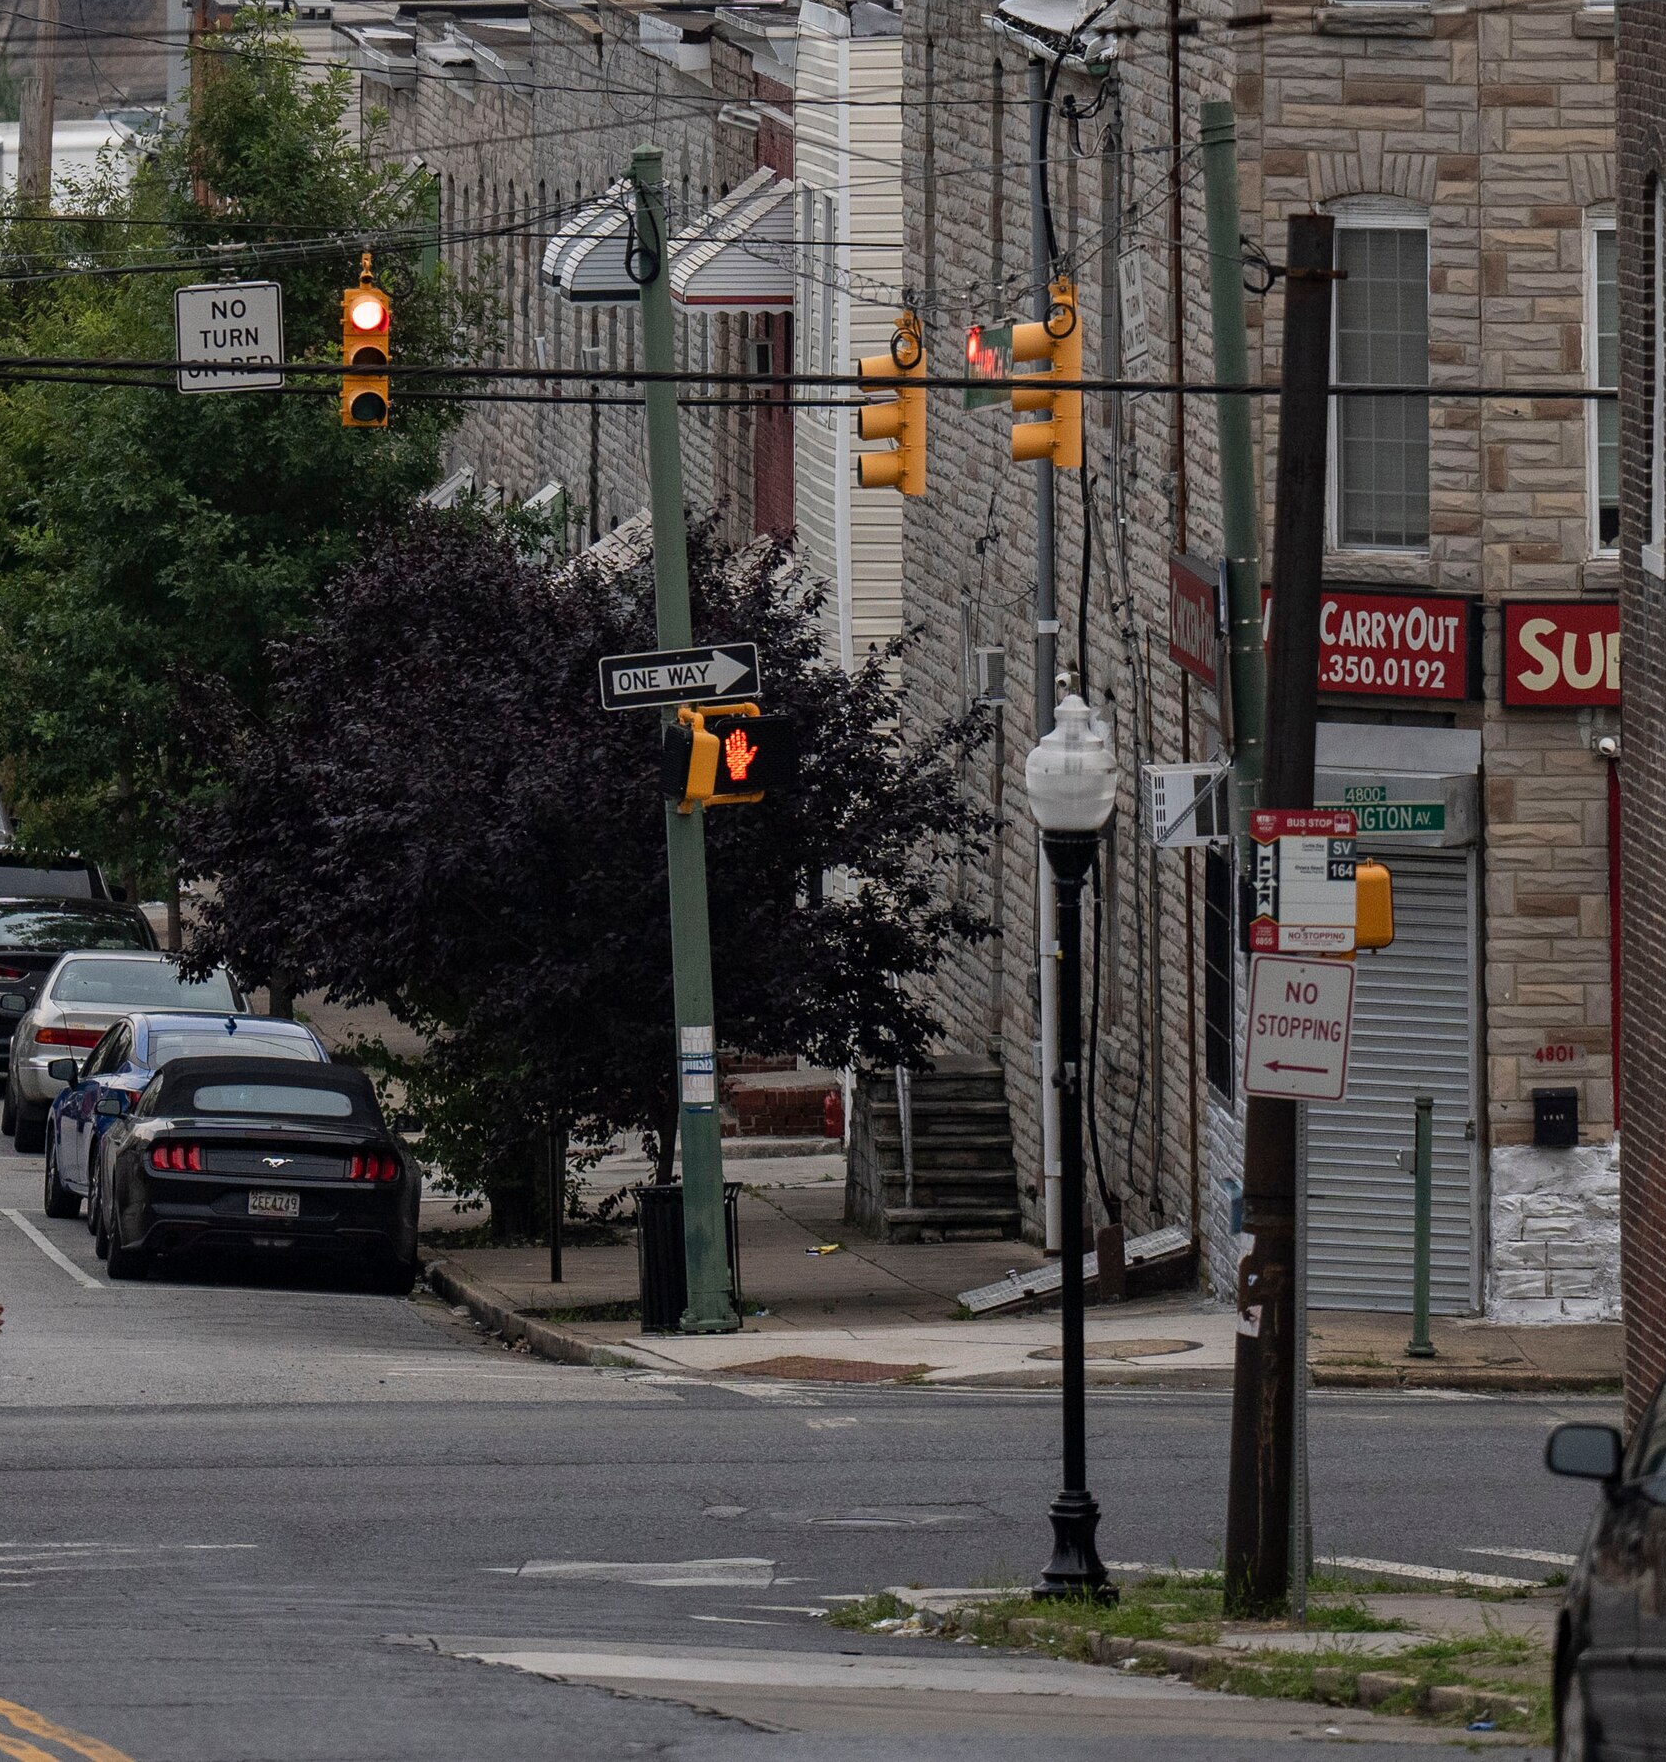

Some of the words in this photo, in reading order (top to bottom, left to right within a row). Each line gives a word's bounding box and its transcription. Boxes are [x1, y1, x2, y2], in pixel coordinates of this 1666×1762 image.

[211, 299, 246, 319] NO
[199, 327, 259, 349] TURN
[619, 669, 660, 691] ONE
[667, 663, 710, 686] WAY
[1318, 654, 1445, 689] .350.0192
[1345, 788, 1381, 802] 4800
[1286, 818, 1306, 827] BUS
[1308, 818, 1333, 827] STOP
[1333, 841, 1352, 855] SV
[1330, 863, 1353, 877] 164
[1288, 931, 1301, 940] NO
[1302, 932, 1346, 942] STOPPING
[1285, 981, 1318, 1004] NO
[1256, 1014, 1342, 1042] STOPPING
[1535, 1045, 1574, 1063] 4801
